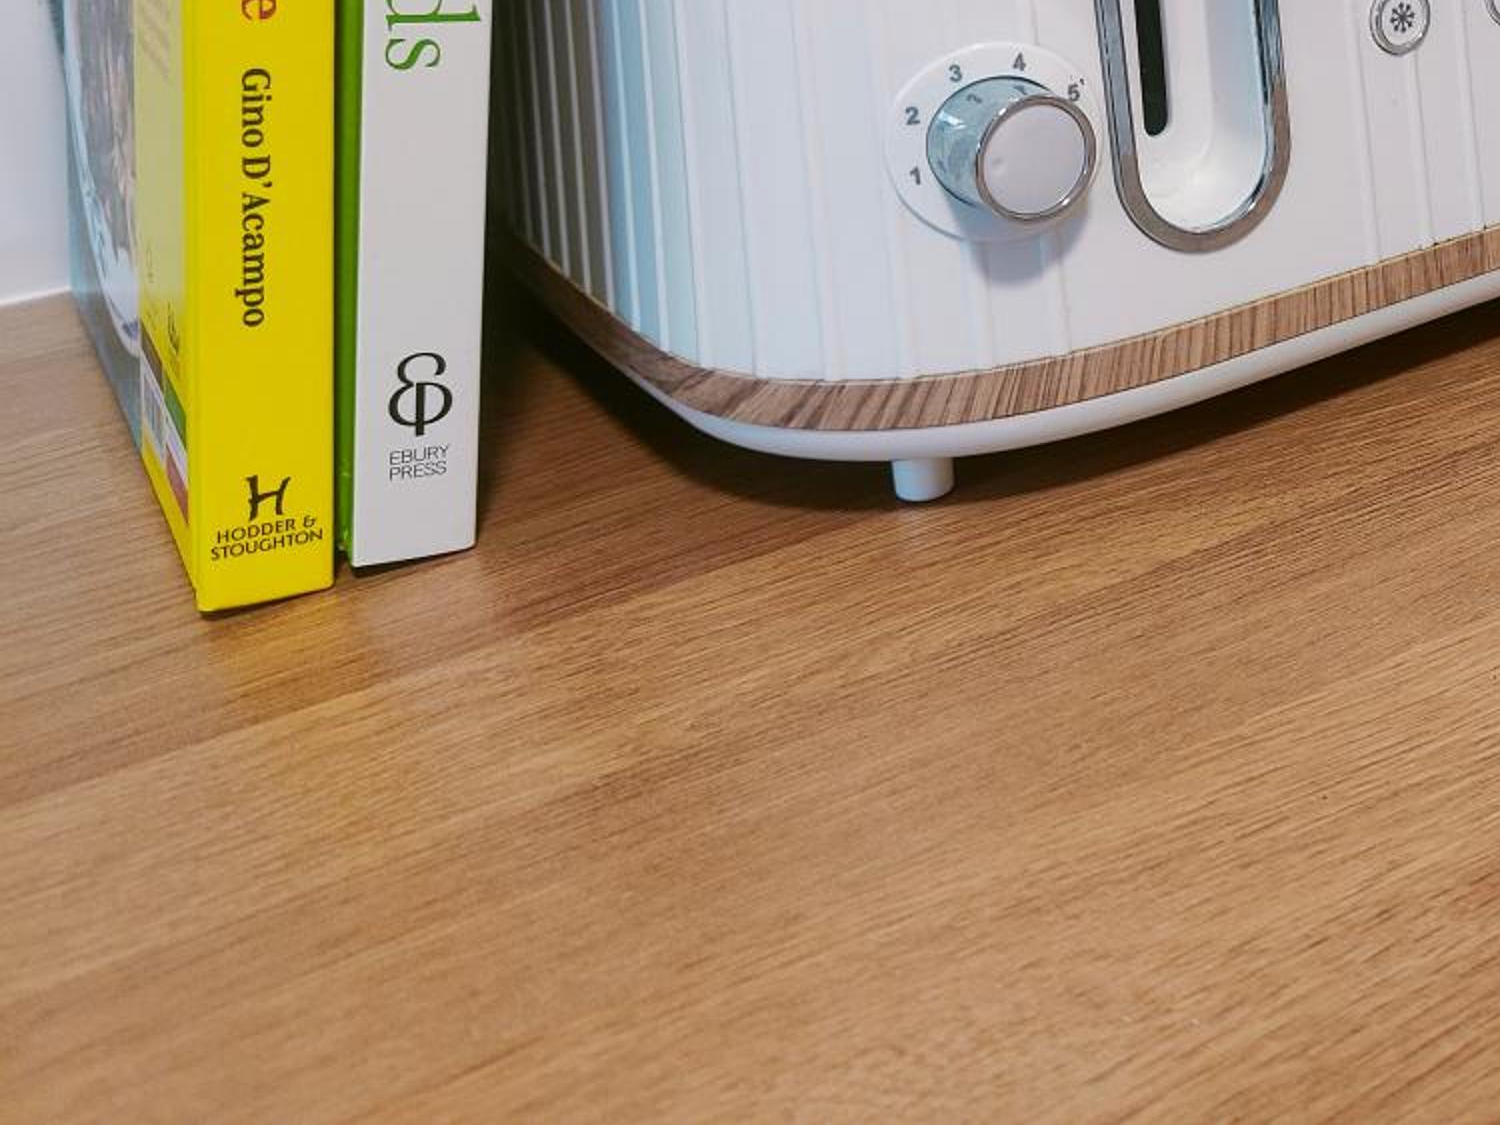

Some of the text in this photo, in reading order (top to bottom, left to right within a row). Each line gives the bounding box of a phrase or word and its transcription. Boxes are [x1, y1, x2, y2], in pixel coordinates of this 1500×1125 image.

[1013, 52, 1026, 71] 4
[949, 64, 964, 82] 3
[241, 68, 273, 148] Gino
[905, 106, 921, 125] 2
[910, 166, 921, 185] 1
[389, 445, 449, 466] EBURY
[389, 460, 447, 481] PRESS
[217, 514, 317, 544] HODDER &
[211, 528, 323, 562] STOUGHTON
